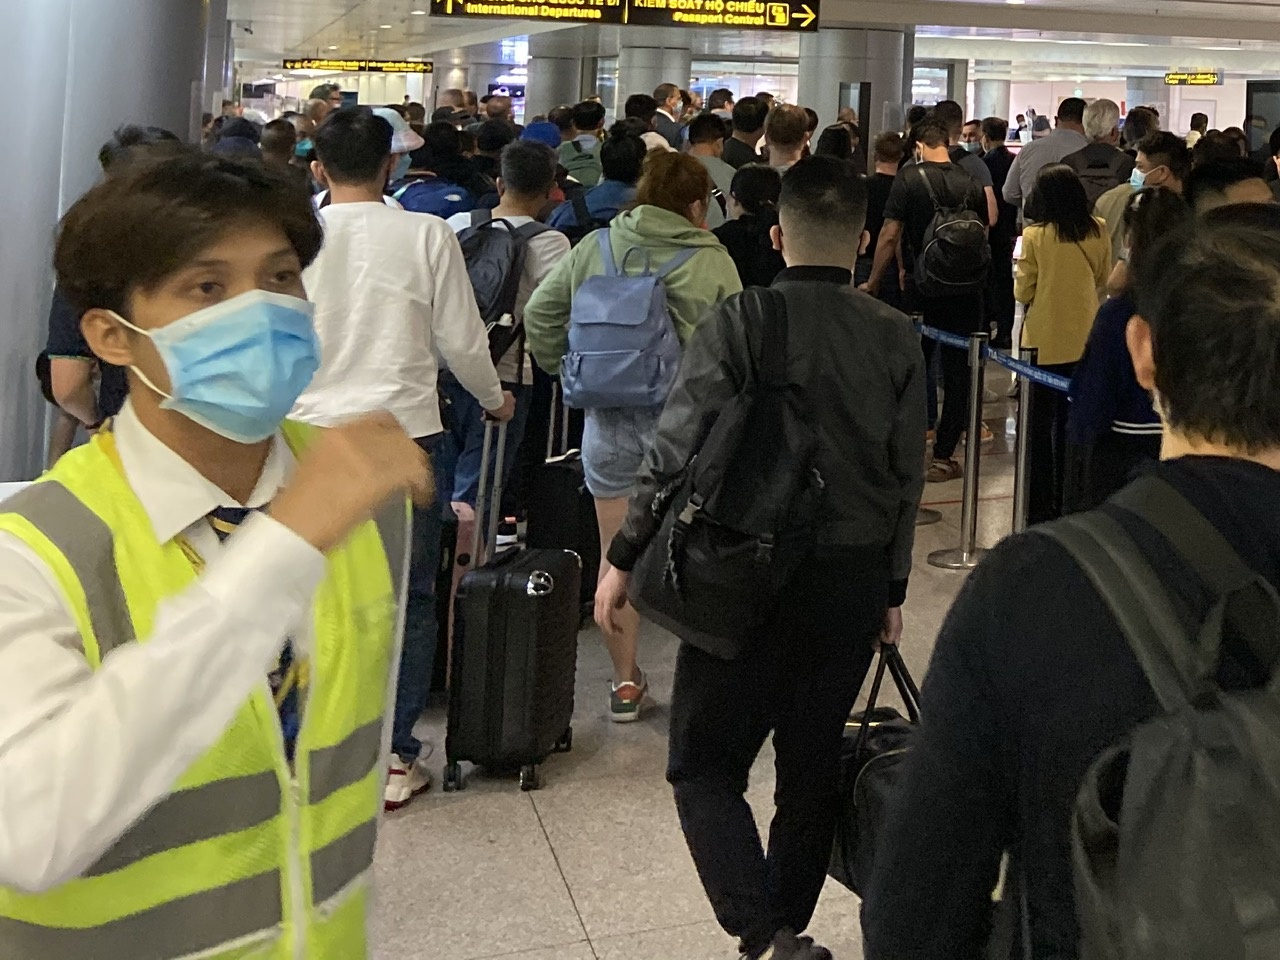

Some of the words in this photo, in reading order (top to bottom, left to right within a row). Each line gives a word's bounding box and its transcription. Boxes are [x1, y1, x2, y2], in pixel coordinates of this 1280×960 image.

[466, 3, 538, 16] International
[540, 5, 602, 19] Departures
[726, 0, 765, 14] CHIẾU
[672, 12, 723, 24] Passport
[724, 13, 765, 26] Control
